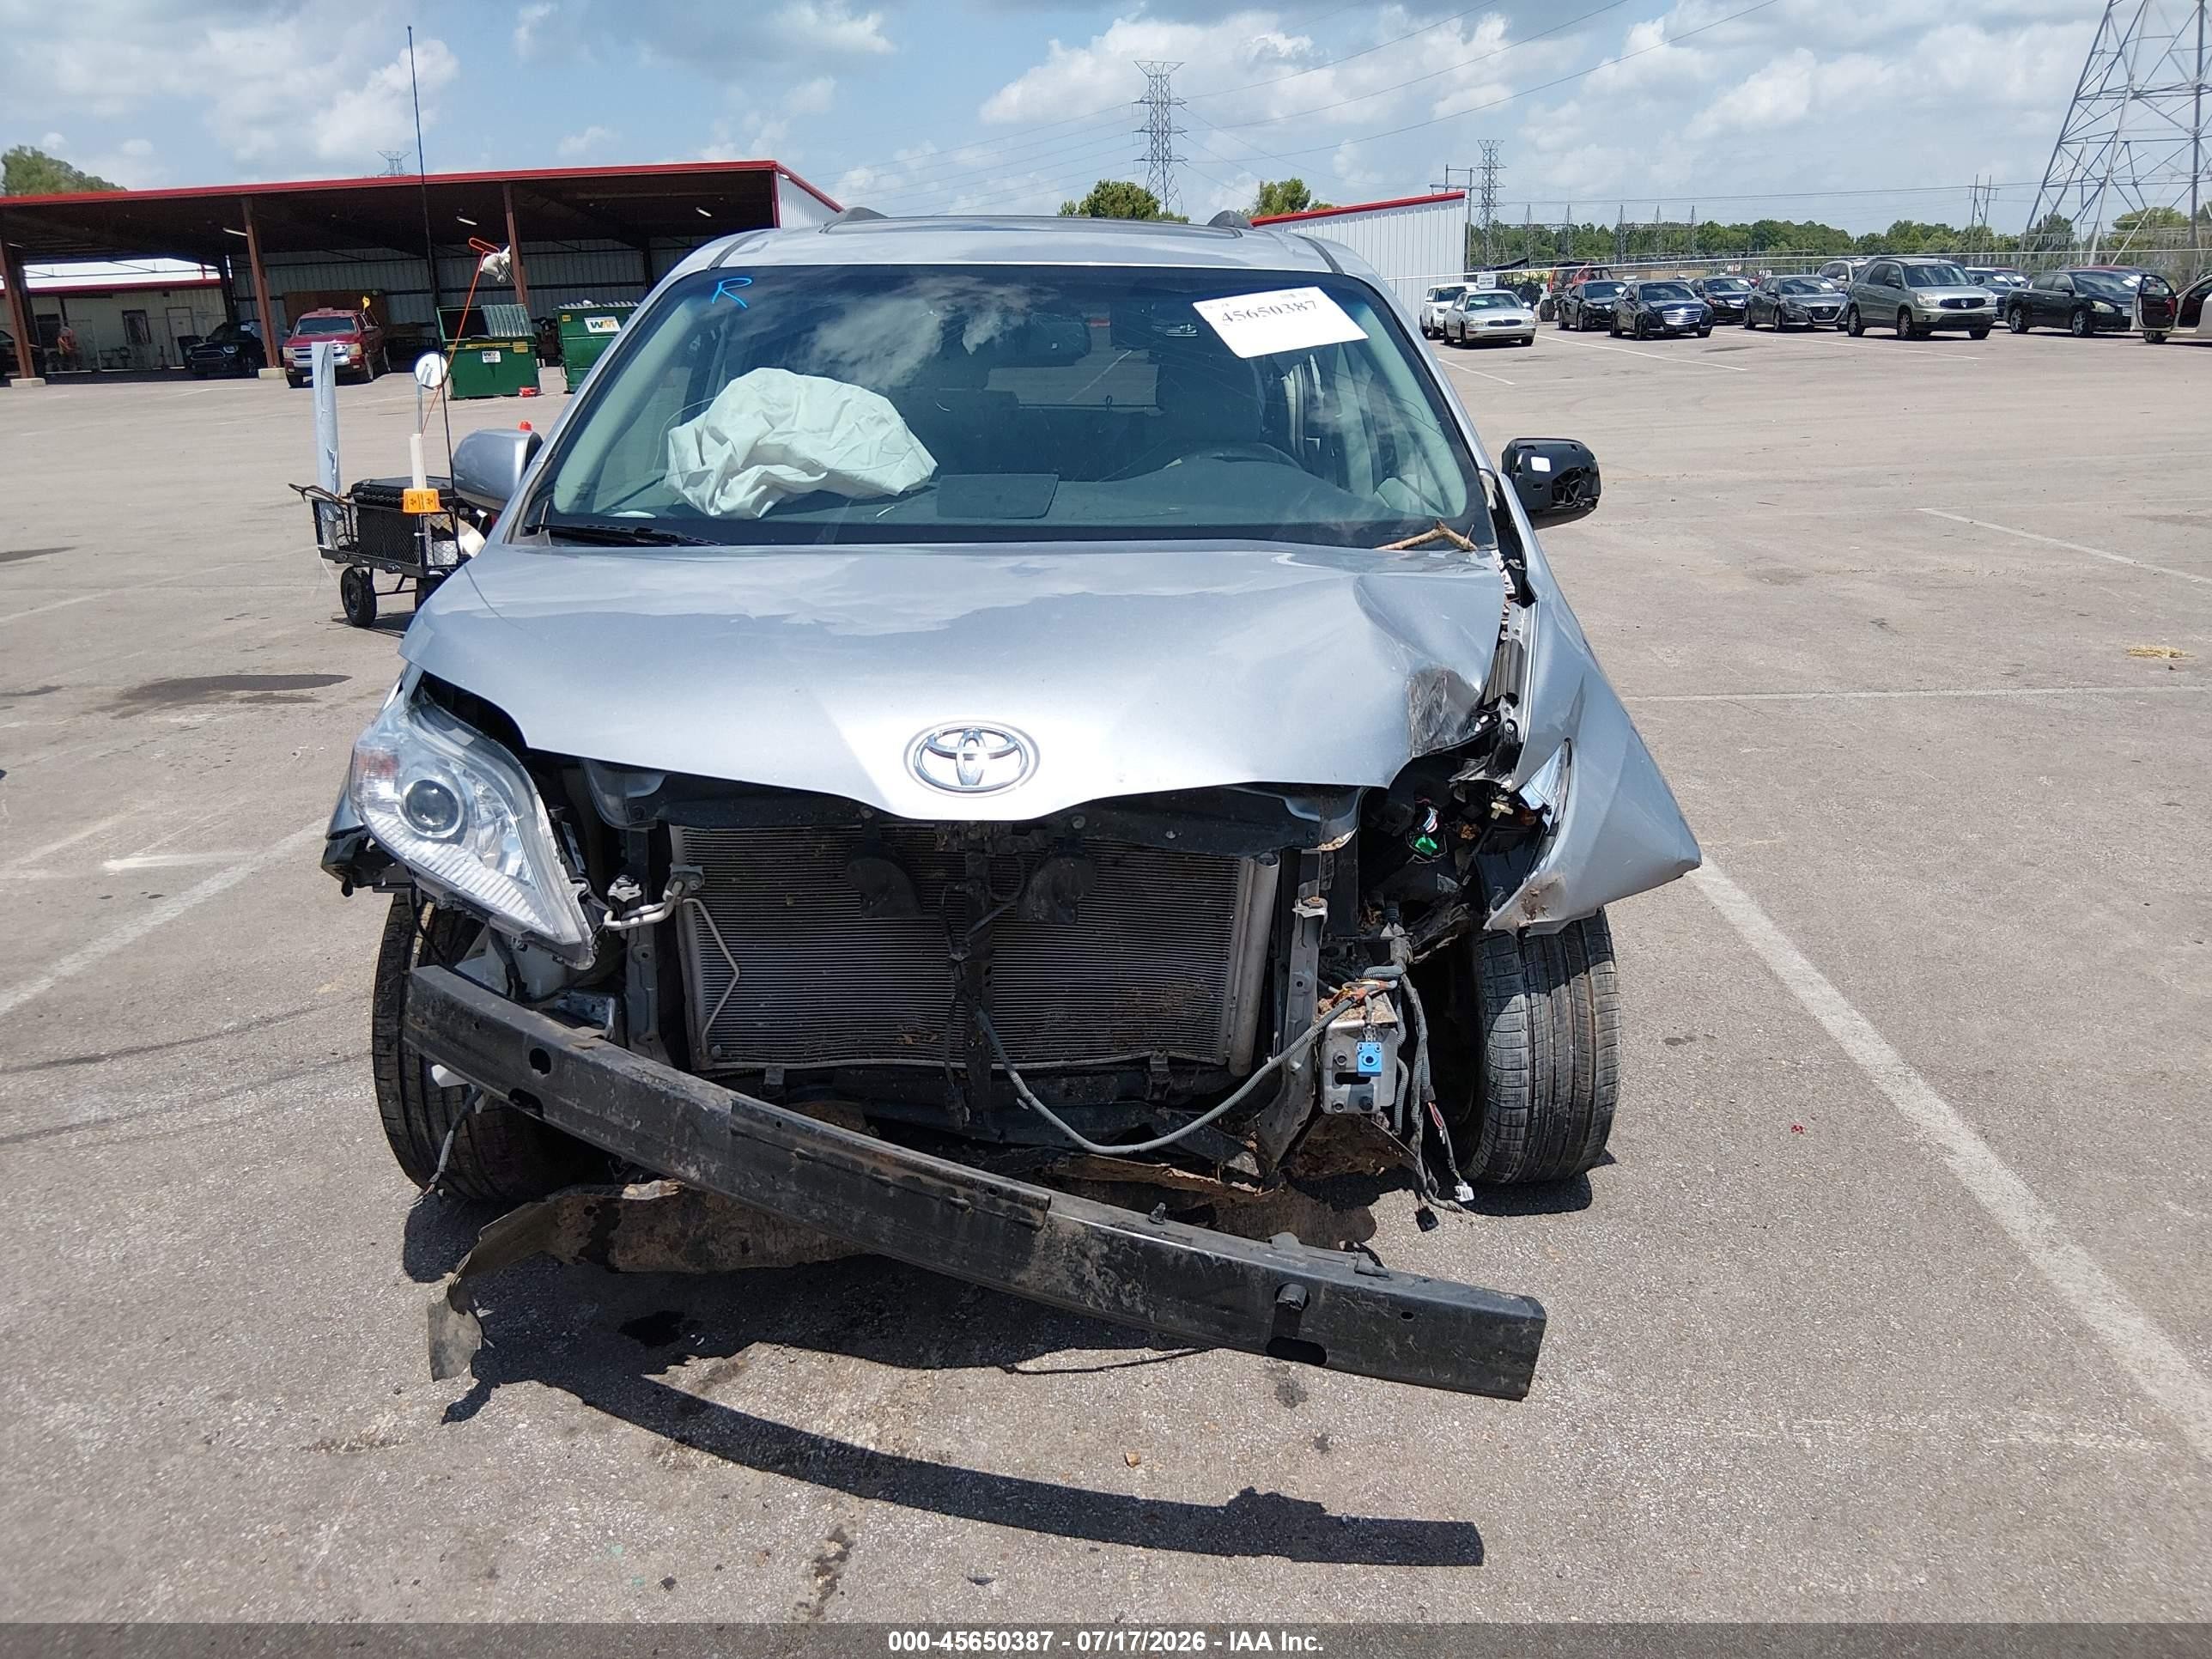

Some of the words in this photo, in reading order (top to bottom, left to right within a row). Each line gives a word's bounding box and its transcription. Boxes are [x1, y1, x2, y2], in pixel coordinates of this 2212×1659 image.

[711, 277, 752, 308] R
[1222, 300, 1318, 323] 45650387
[590, 319, 616, 329] WM
